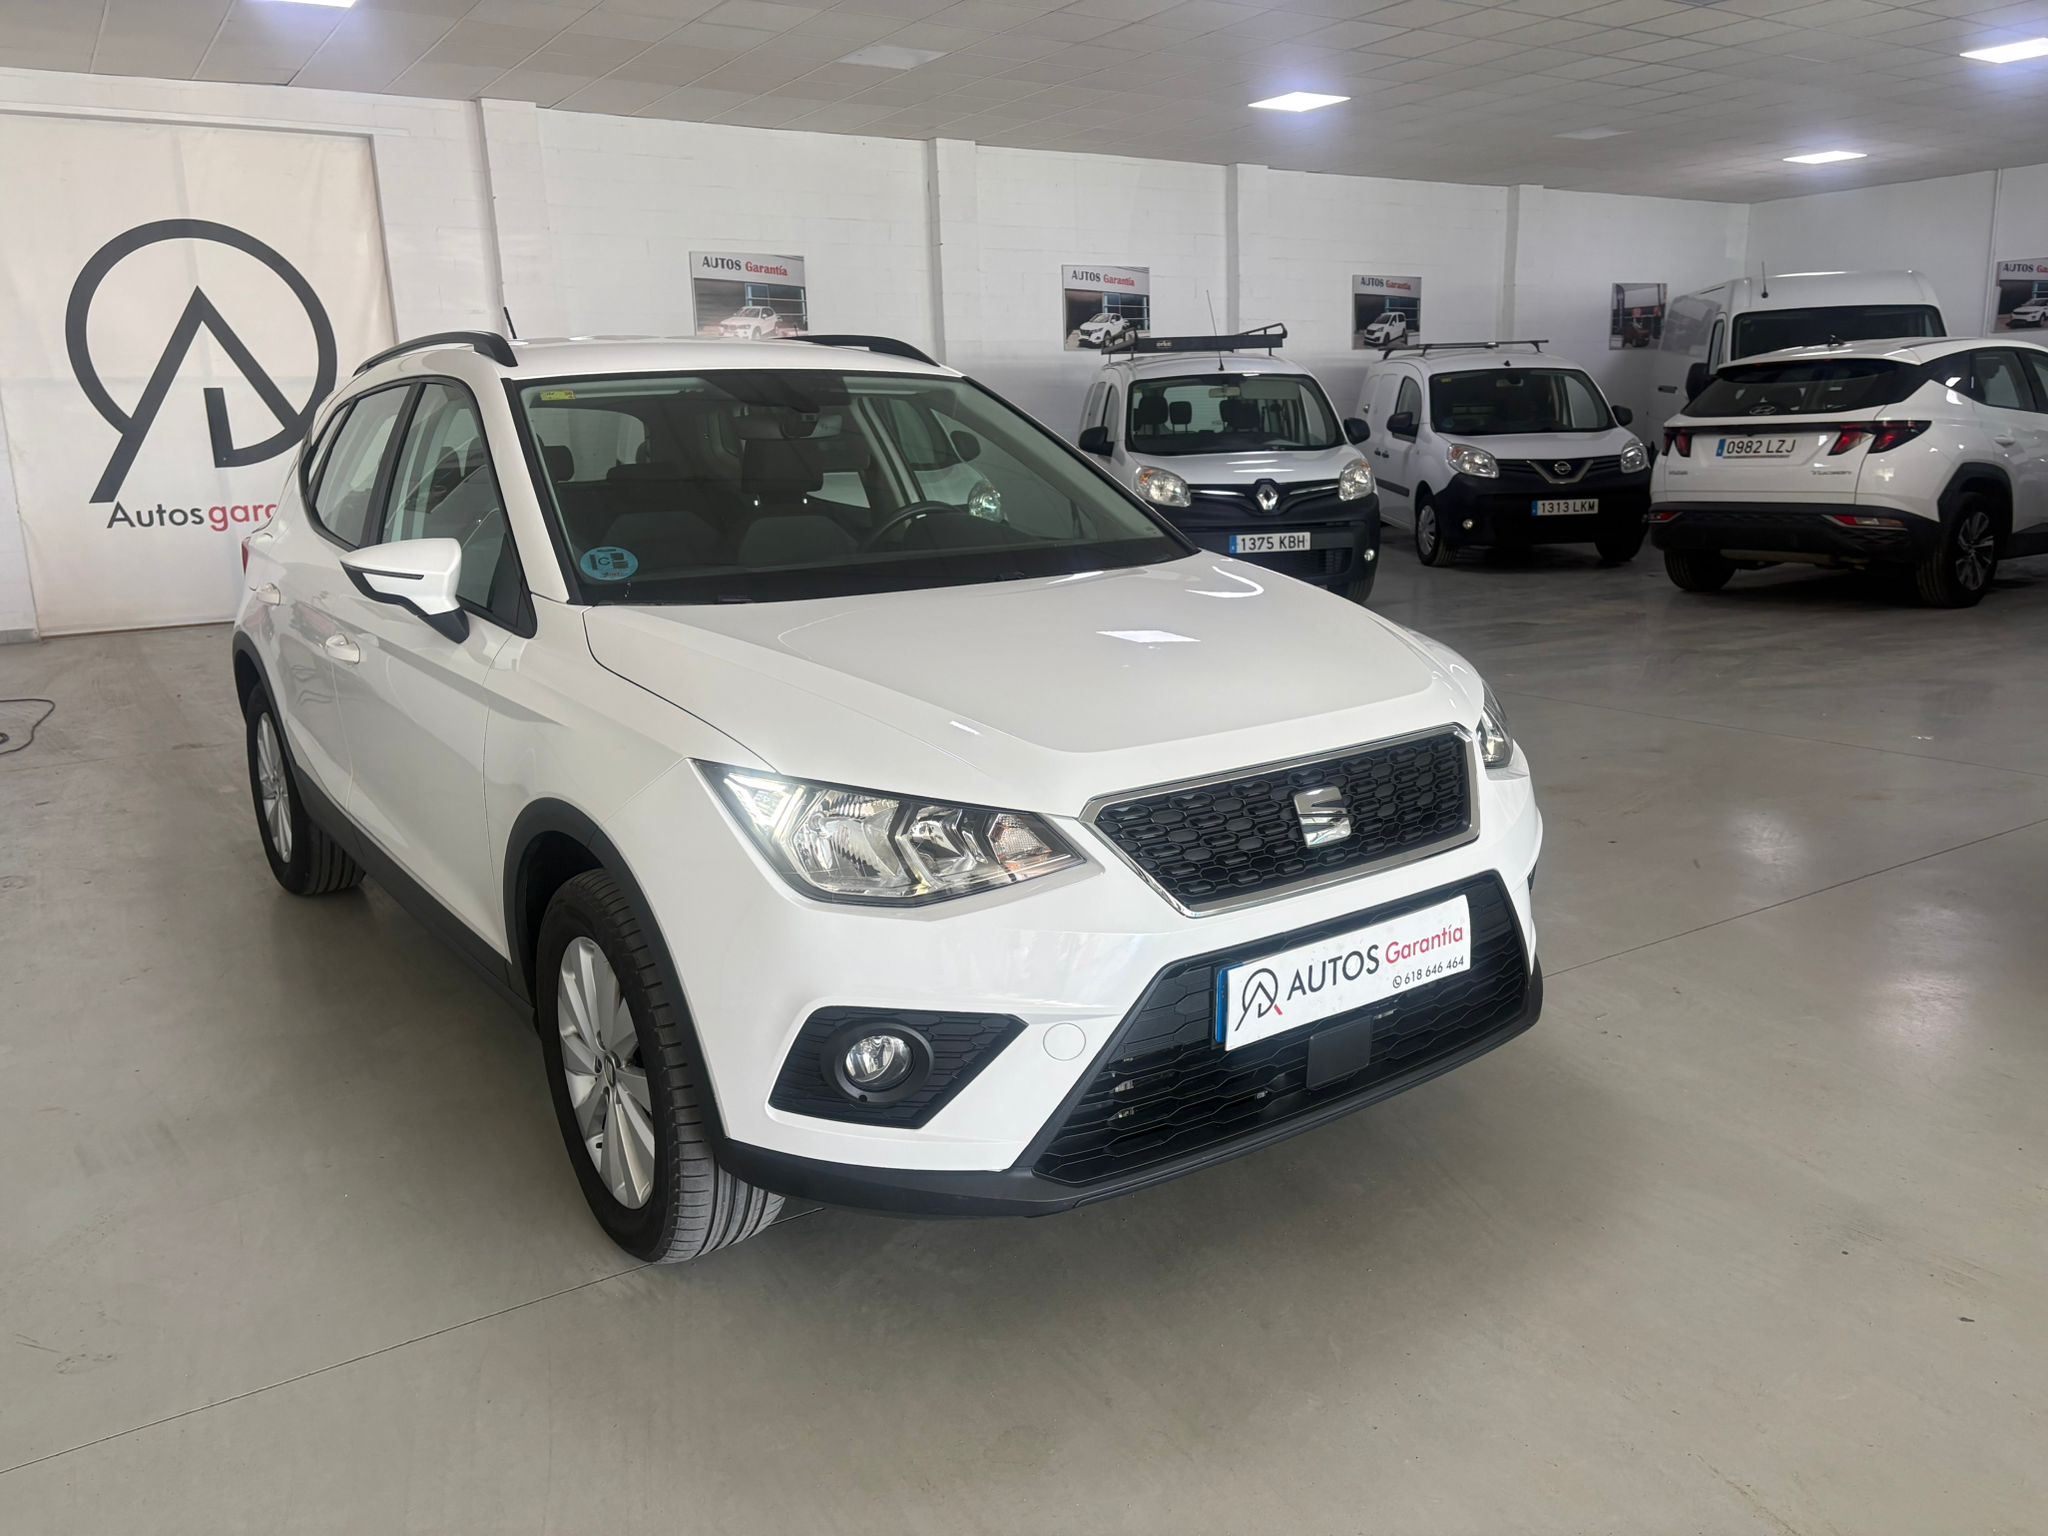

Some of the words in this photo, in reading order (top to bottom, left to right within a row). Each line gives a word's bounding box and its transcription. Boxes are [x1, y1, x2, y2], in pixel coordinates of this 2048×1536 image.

[702, 255, 741, 271] AUTOS
[745, 261, 789, 276] Garantía
[2003, 263, 2034, 273] AUTOS
[1072, 270, 1101, 282] AUTOS
[1361, 276, 1384, 288] AUTOS
[1726, 440, 1763, 454] 0982
[1766, 439, 1797, 454] LZJ
[1541, 501, 1569, 513] 1313
[1573, 500, 1595, 512] LKM
[106, 501, 204, 529] Autos
[1240, 536, 1274, 551] 1375
[1279, 535, 1305, 550] KBH
[1286, 944, 1380, 1001] AUTOS
[1385, 924, 1463, 965] Garantía
[1404, 969, 1423, 985] 618
[1425, 962, 1443, 978] 646
[1445, 955, 1465, 971] 464
